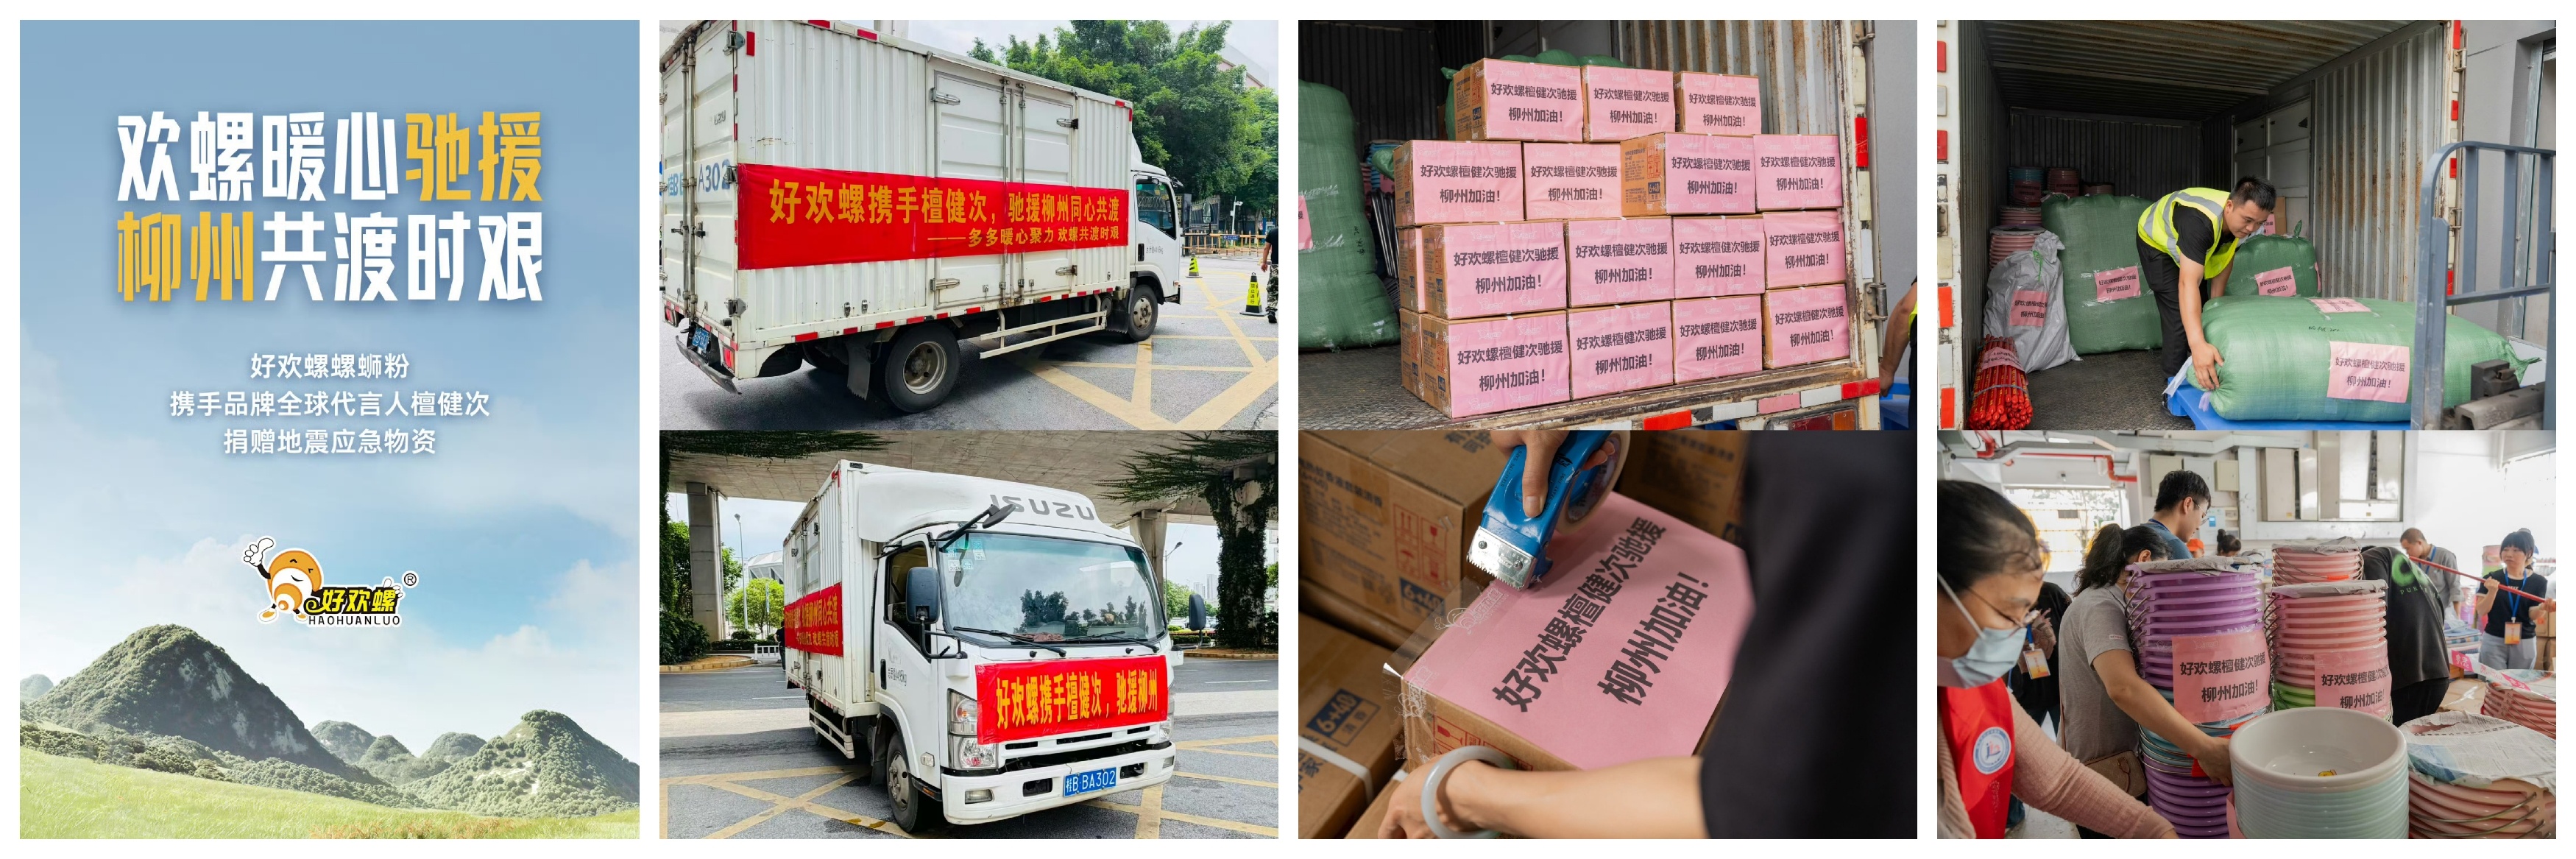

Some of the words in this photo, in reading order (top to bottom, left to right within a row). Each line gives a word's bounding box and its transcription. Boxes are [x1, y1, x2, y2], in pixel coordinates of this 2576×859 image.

[1491, 83, 1577, 101] 好欢螺檀健次驰援
[1593, 88, 1669, 103] 好欢螺檀健次驰援
[1688, 93, 1757, 107] 好欢螺檀健次驰援
[1508, 107, 1563, 123] 柳州加油！
[1610, 110, 1658, 124] 柳州加油！
[1703, 113, 1746, 127] 柳州加油！
[117, 111, 543, 202] 欢螺暖心驰援
[1671, 156, 1751, 172] 好欢螺檀健次驰援
[1760, 156, 1836, 168] 好欢螺檀健次驰援
[1420, 165, 1517, 179] 好欢螺檀健次驰援
[1531, 165, 1617, 178] 好欢螺檀健次驰援
[1687, 180, 1738, 195] 柳州加油！
[1776, 177, 1824, 191] 柳州加油！
[1440, 188, 1500, 203] 柳州加油！
[1548, 187, 1603, 201] 柳州加油！
[1679, 240, 1761, 255] 好欢螺檀健次驰援
[1769, 230, 1840, 247] 好欢螺檀健次驰援
[117, 211, 543, 301] 柳州共渡时艰
[1454, 247, 1560, 267] 好欢螺檀健次驰援
[1575, 241, 1668, 258] 好欢螺檀健次驰援
[1785, 253, 1829, 269] 柳州加油！
[1594, 266, 1653, 284] 柳州加油！
[1695, 264, 1747, 279] 柳州加油！
[1475, 275, 1542, 294] 柳州加油！
[1775, 305, 1844, 325] 好欢螺檀健次驰援
[1679, 318, 1758, 338] 好欢螺檀健次驰援
[1576, 326, 1667, 351] 好欢螺檀健次驰援
[1790, 329, 1834, 347] 柳州加油！
[1457, 339, 1563, 366] 好欢螺檀健次驰援
[1696, 342, 1745, 361] 柳州加油！
[250, 353, 410, 380] 好欢螺螺蛳粉
[1595, 353, 1653, 375] 柳州加油！
[2335, 356, 2405, 372] 好欢螺檀健次驰援
[1479, 368, 1546, 392] 柳州加油！
[2346, 375, 2391, 389] 柳州加油！
[170, 391, 490, 418] 携手品牌全球代言人檀健次
[223, 428, 436, 456] 捐赠地震应急物资
[307, 588, 397, 613] 好欢螺
[308, 615, 400, 625] HAOHUANLUO
[1492, 517, 1668, 713] 好欢螺檀健次驰援
[1596, 571, 1709, 706] 柳州加油！
[2179, 652, 2266, 676] 好欢螺檀健次驰援
[2201, 679, 2259, 703] 柳州加油！
